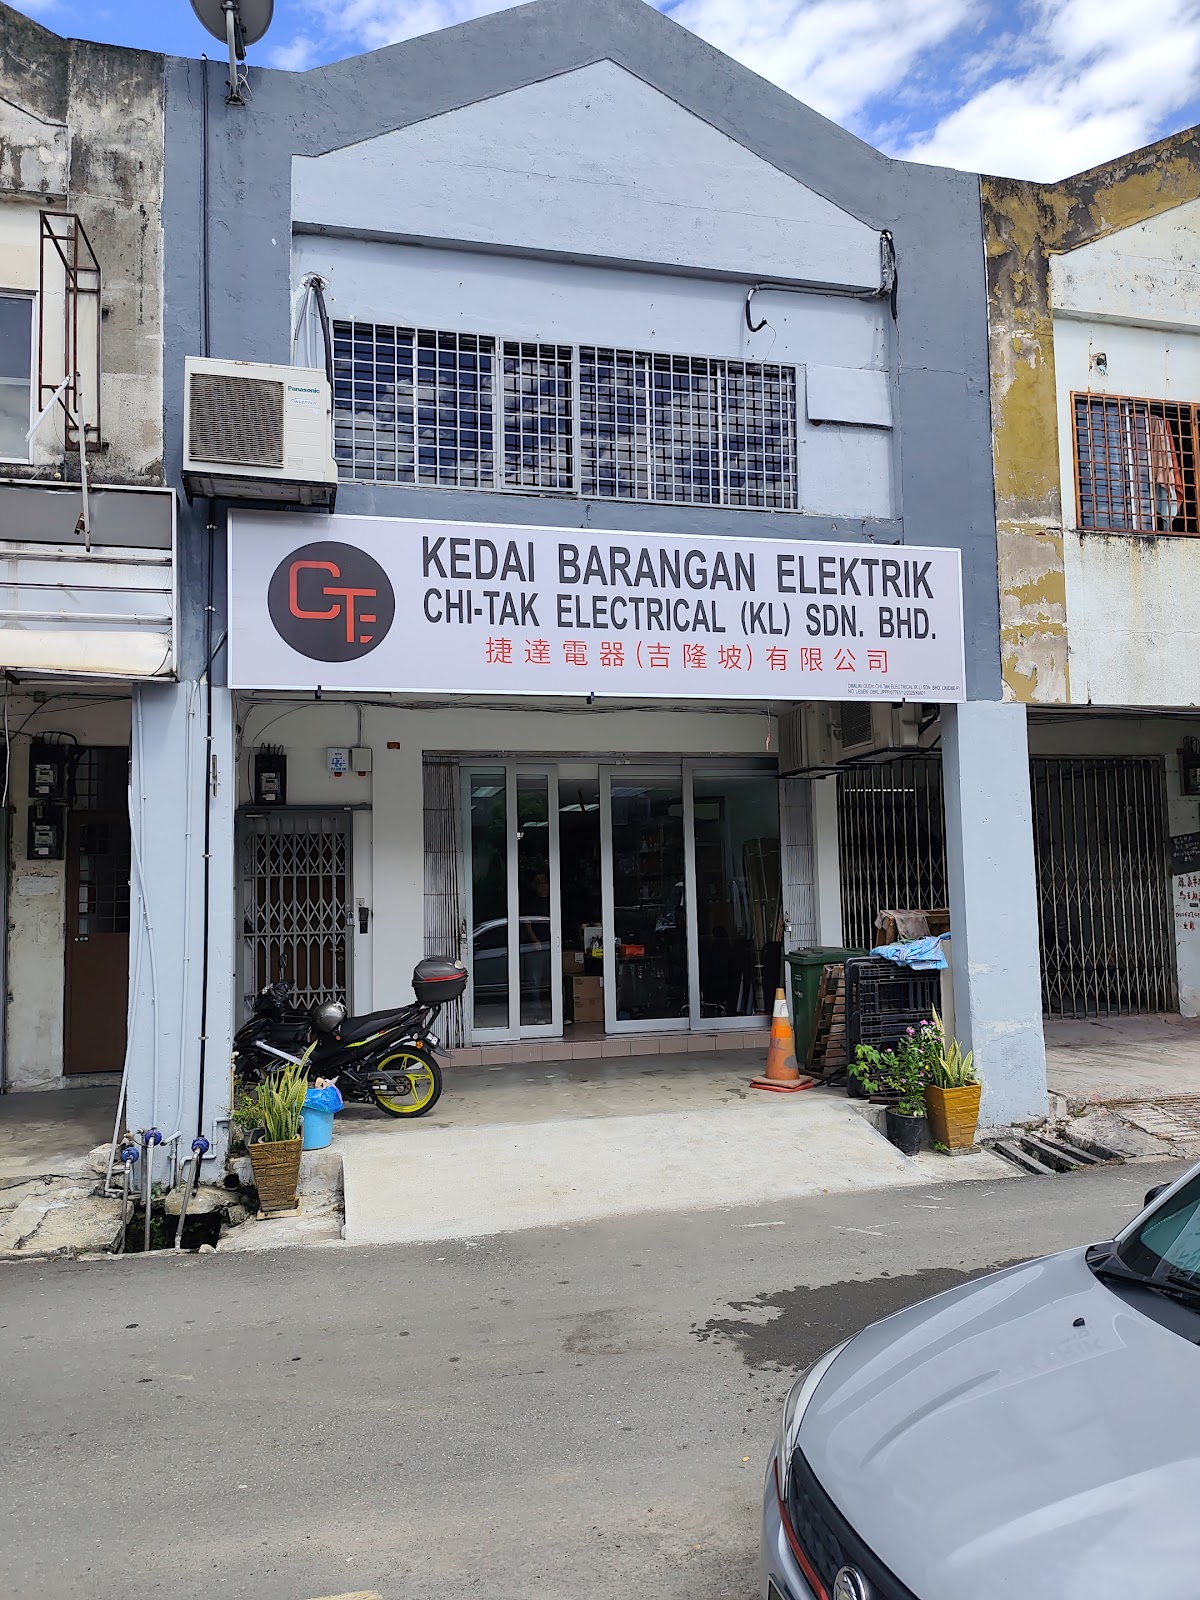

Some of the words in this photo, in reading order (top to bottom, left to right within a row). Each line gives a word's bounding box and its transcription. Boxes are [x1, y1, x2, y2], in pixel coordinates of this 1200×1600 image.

[287, 385, 321, 394] Panasonic
[422, 535, 535, 583] KEDAI
[558, 543, 756, 592] BARANGAN
[776, 554, 934, 599] ELEKTRIK
[423, 587, 541, 627] CHI-TAK
[556, 593, 726, 633] ELECTRICAL
[740, 600, 791, 637] (KL)
[805, 603, 864, 638] SDN.
[878, 606, 936, 640] BHD.
